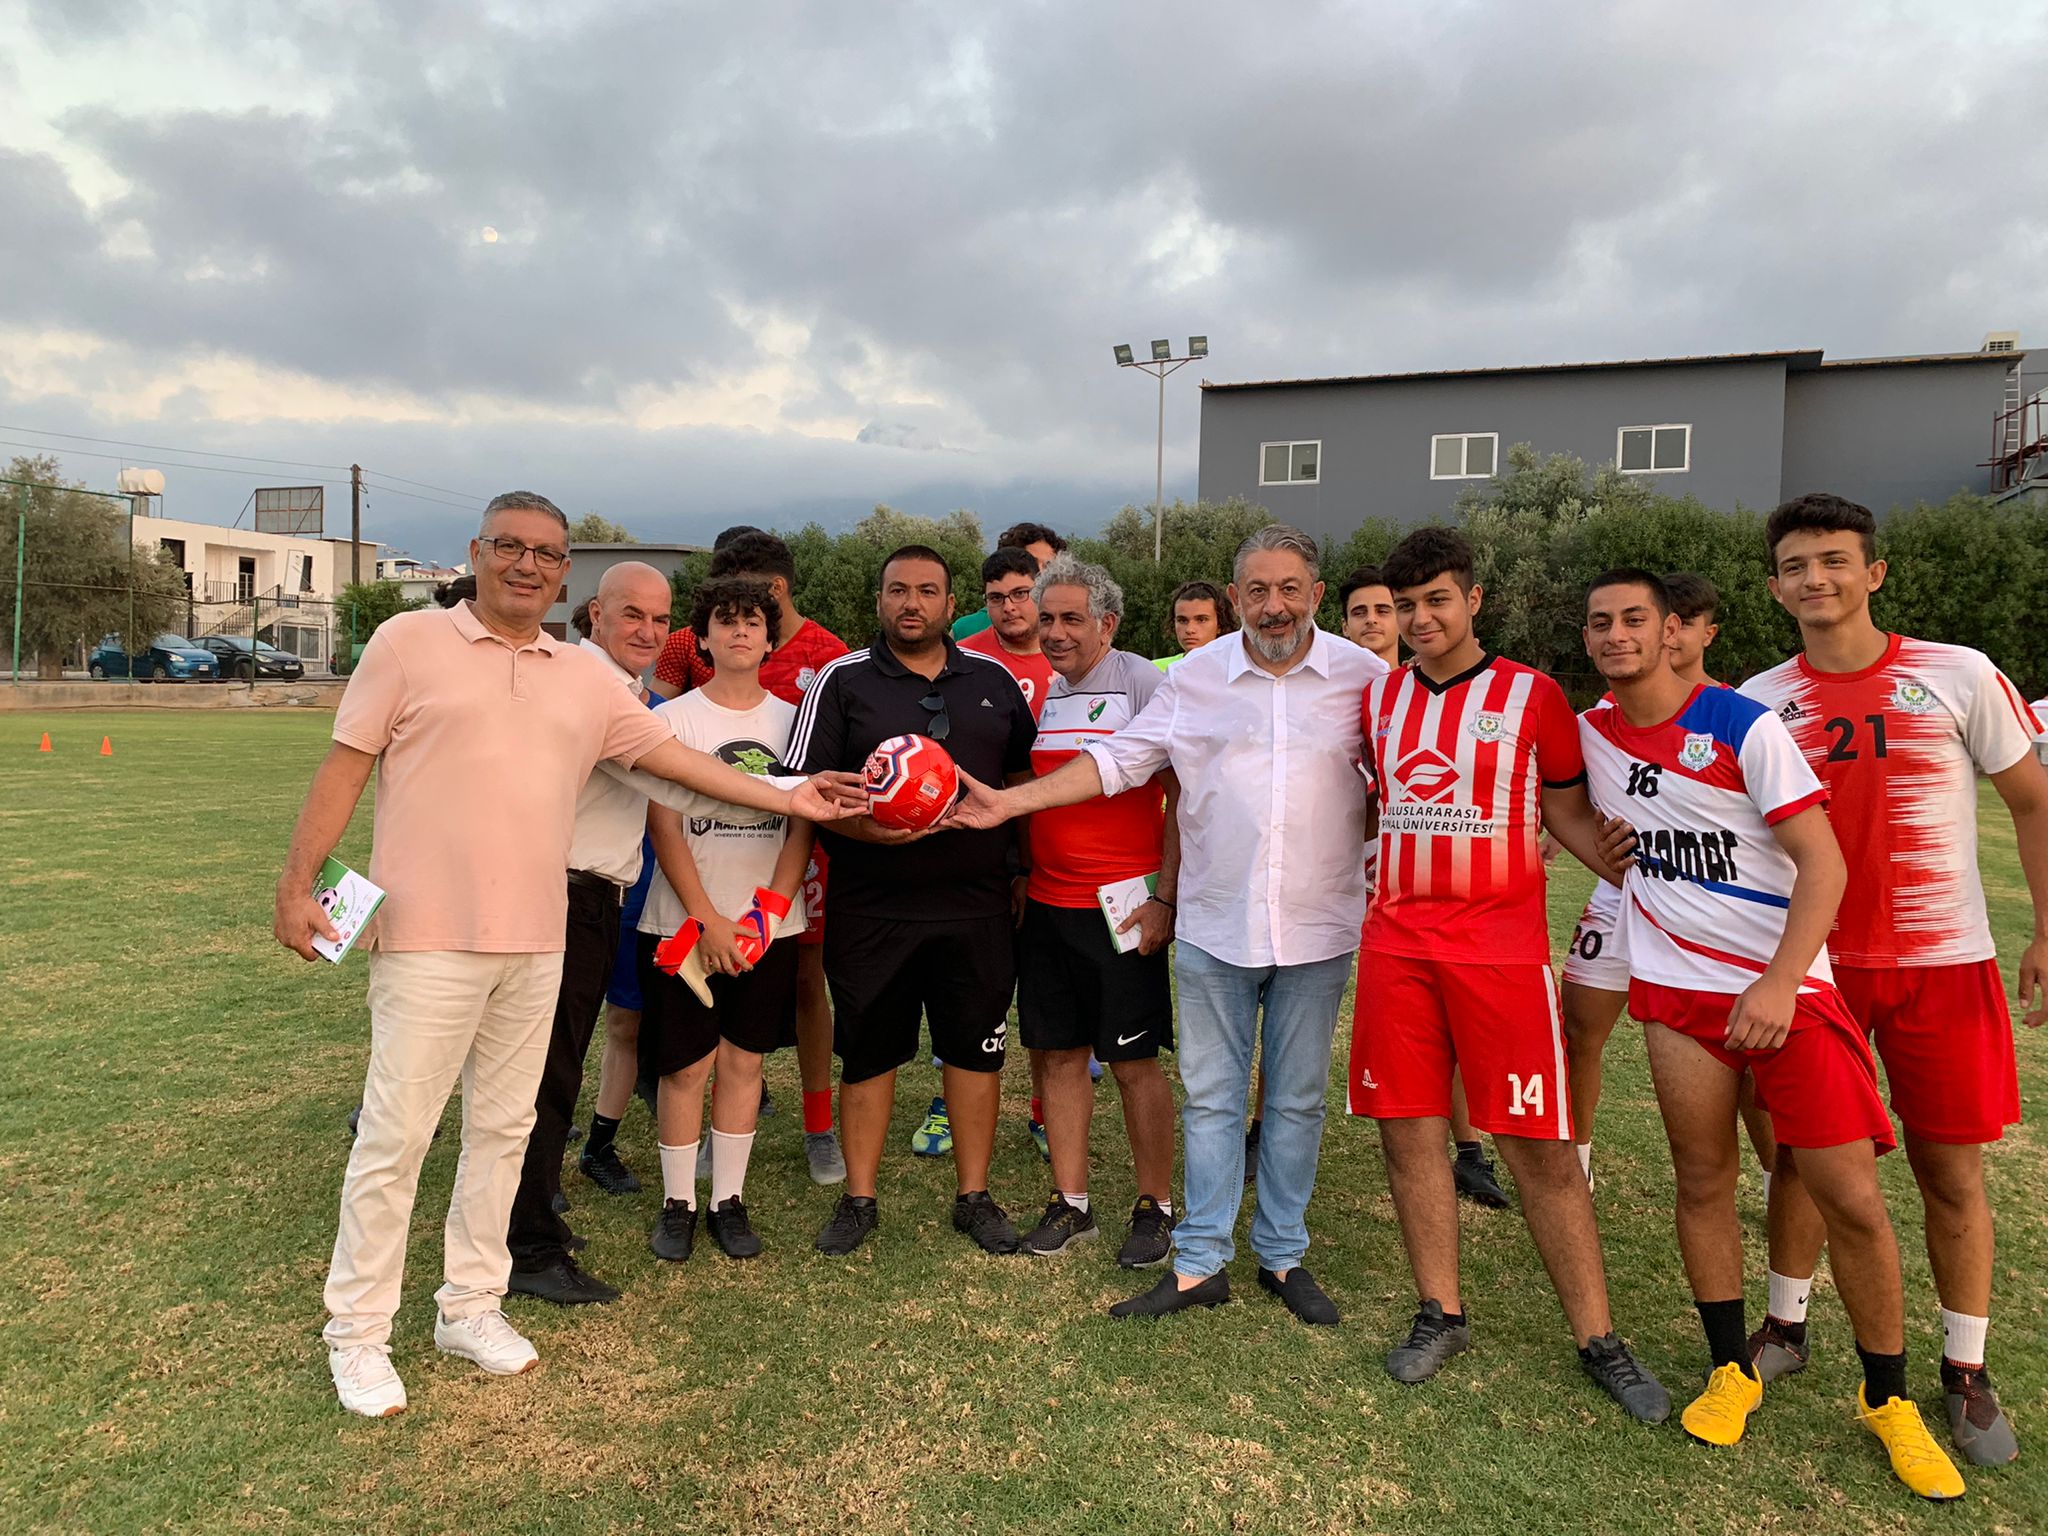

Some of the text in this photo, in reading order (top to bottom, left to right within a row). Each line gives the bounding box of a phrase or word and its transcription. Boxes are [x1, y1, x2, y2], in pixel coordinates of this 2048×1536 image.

[1823, 714, 1888, 764] 21
[1625, 762, 1663, 798] 16
[1507, 1073, 1544, 1116] 14
